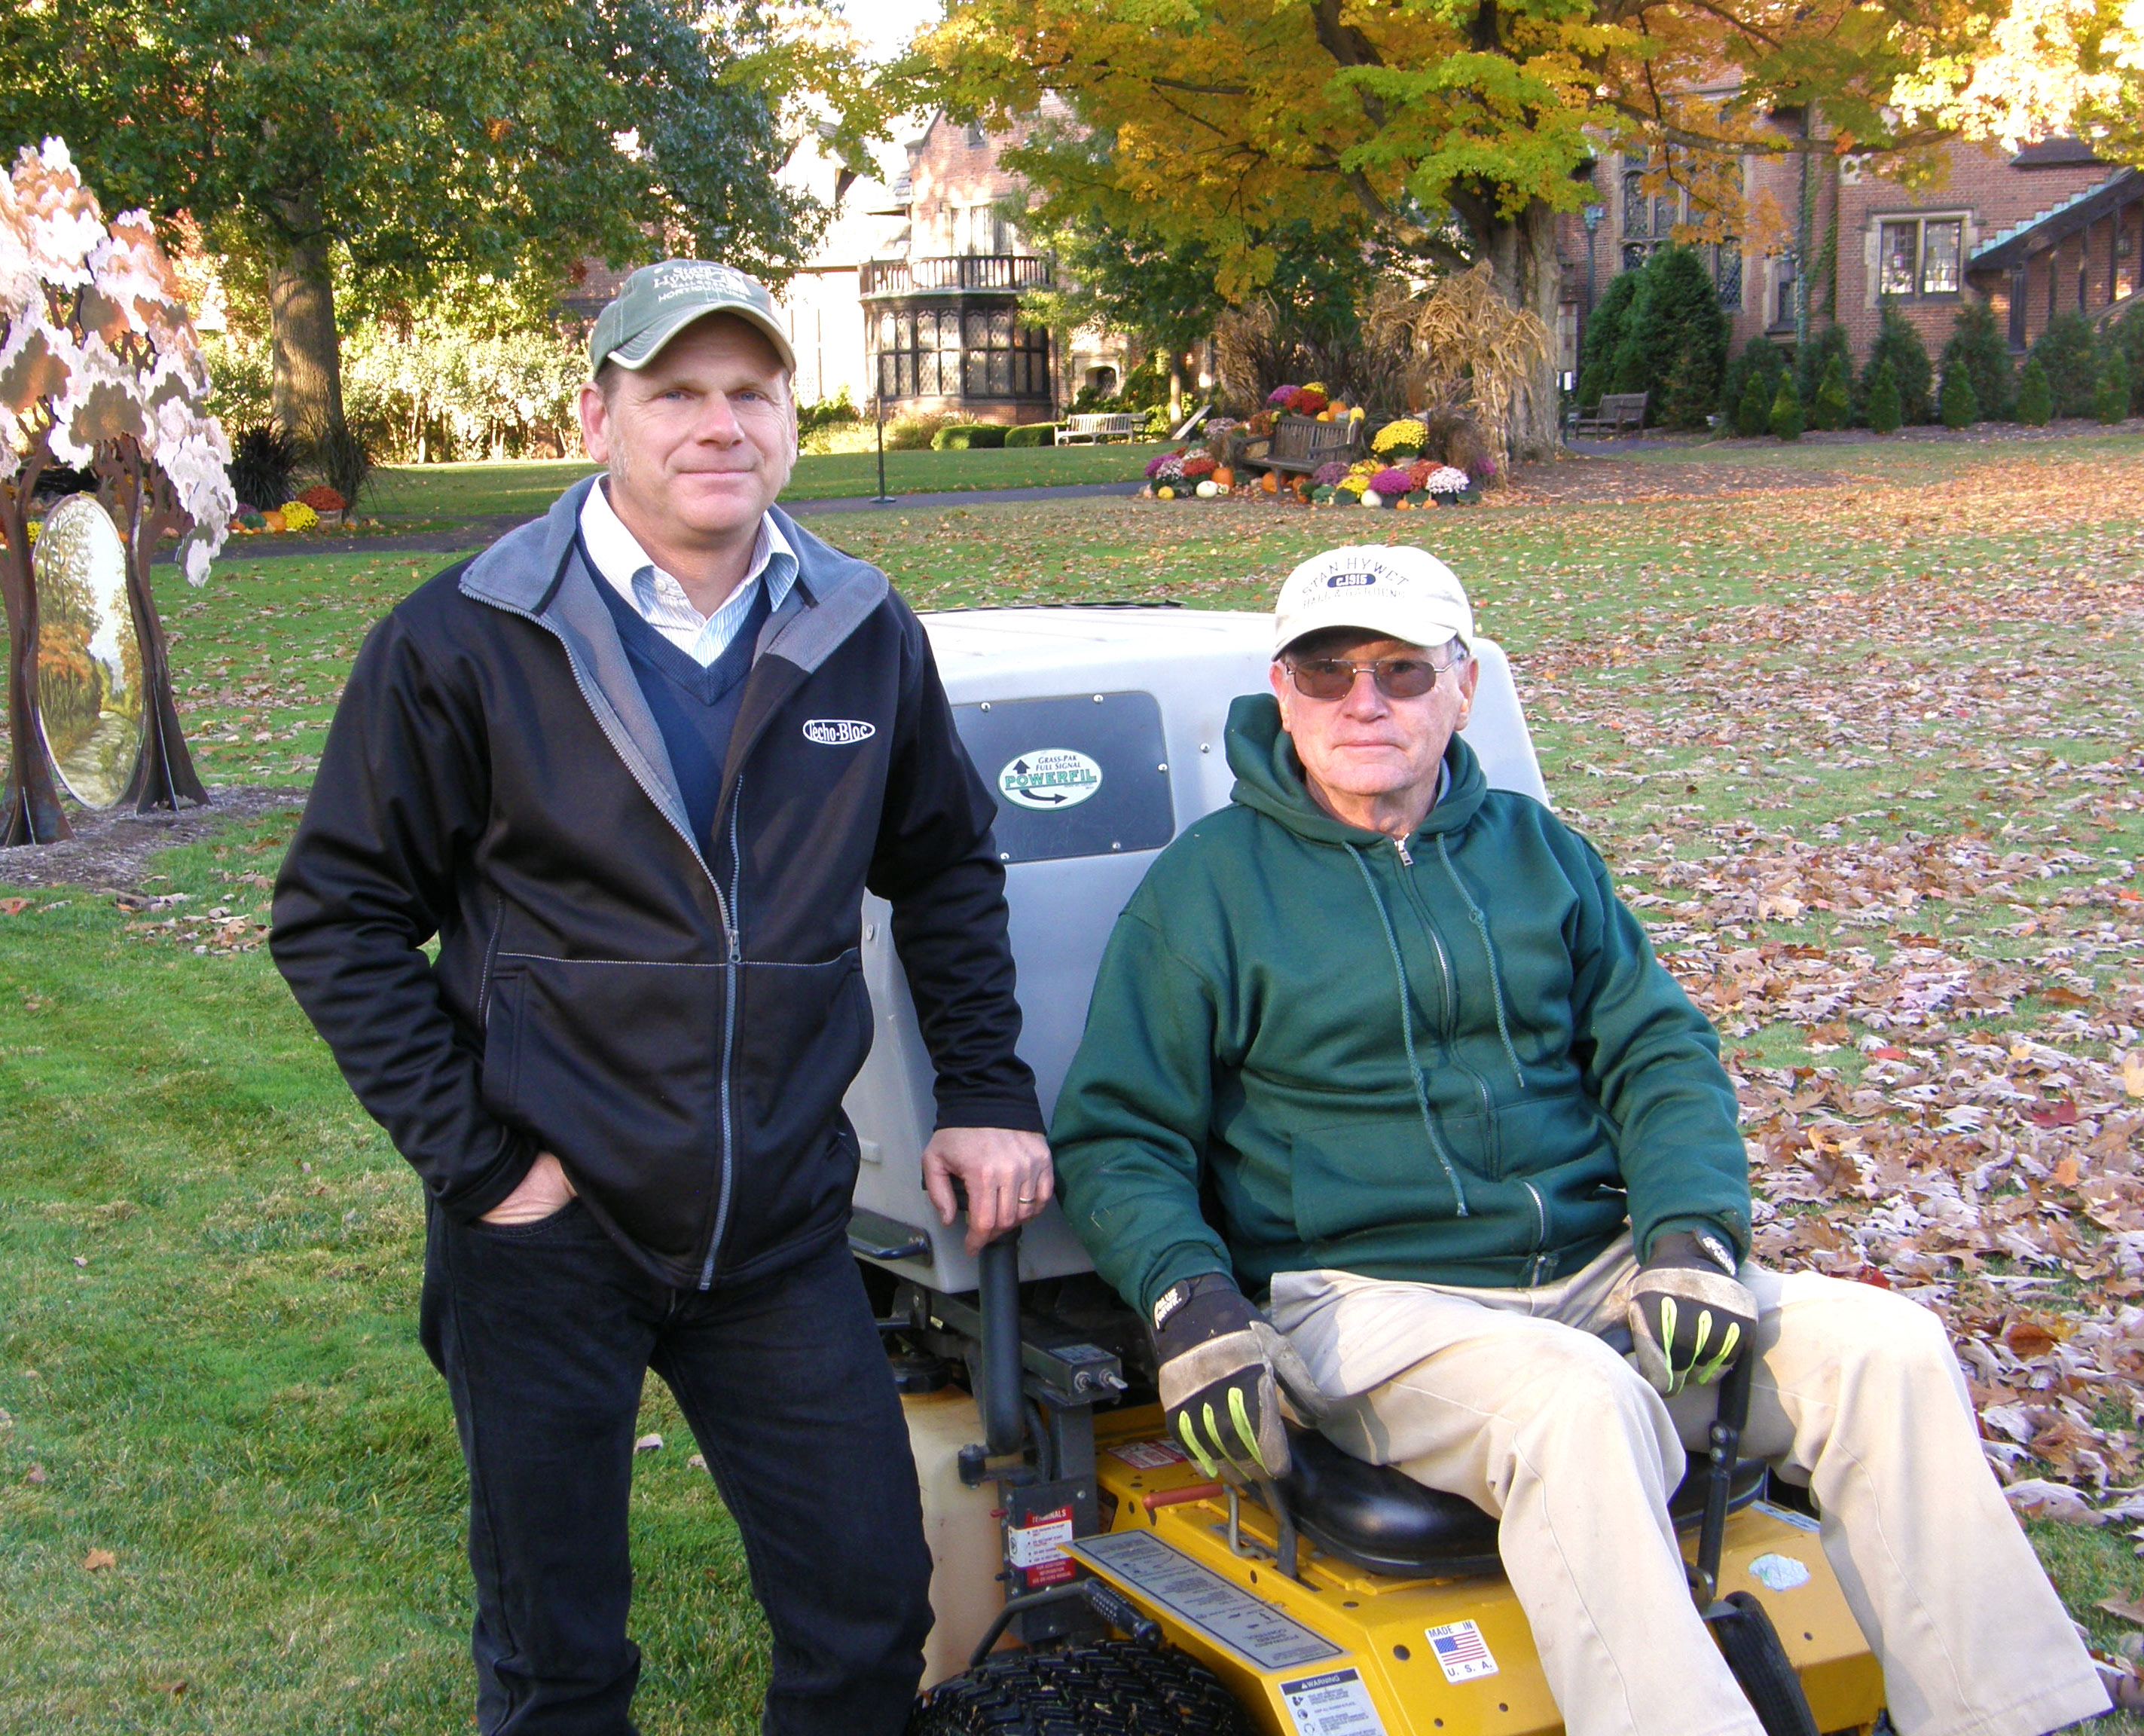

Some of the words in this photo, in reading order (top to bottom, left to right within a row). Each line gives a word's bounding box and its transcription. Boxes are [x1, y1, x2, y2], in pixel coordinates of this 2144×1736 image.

[658, 285, 748, 302] HORTICULTURE
[1303, 562, 1338, 595] STAN
[1345, 587, 1405, 599] GARDENS
[809, 722, 868, 741] Techo-Bloc
[1036, 763, 1052, 772] FULL
[1055, 761, 1081, 770] SIGNAL
[1038, 754, 1077, 764] GRASS-PAK
[1005, 769, 1098, 788] POWERFIL
[1428, 1625, 1454, 1638] MADE
[1462, 1621, 1474, 1631] IN
[1306, 1675, 1340, 1688] WARNING
